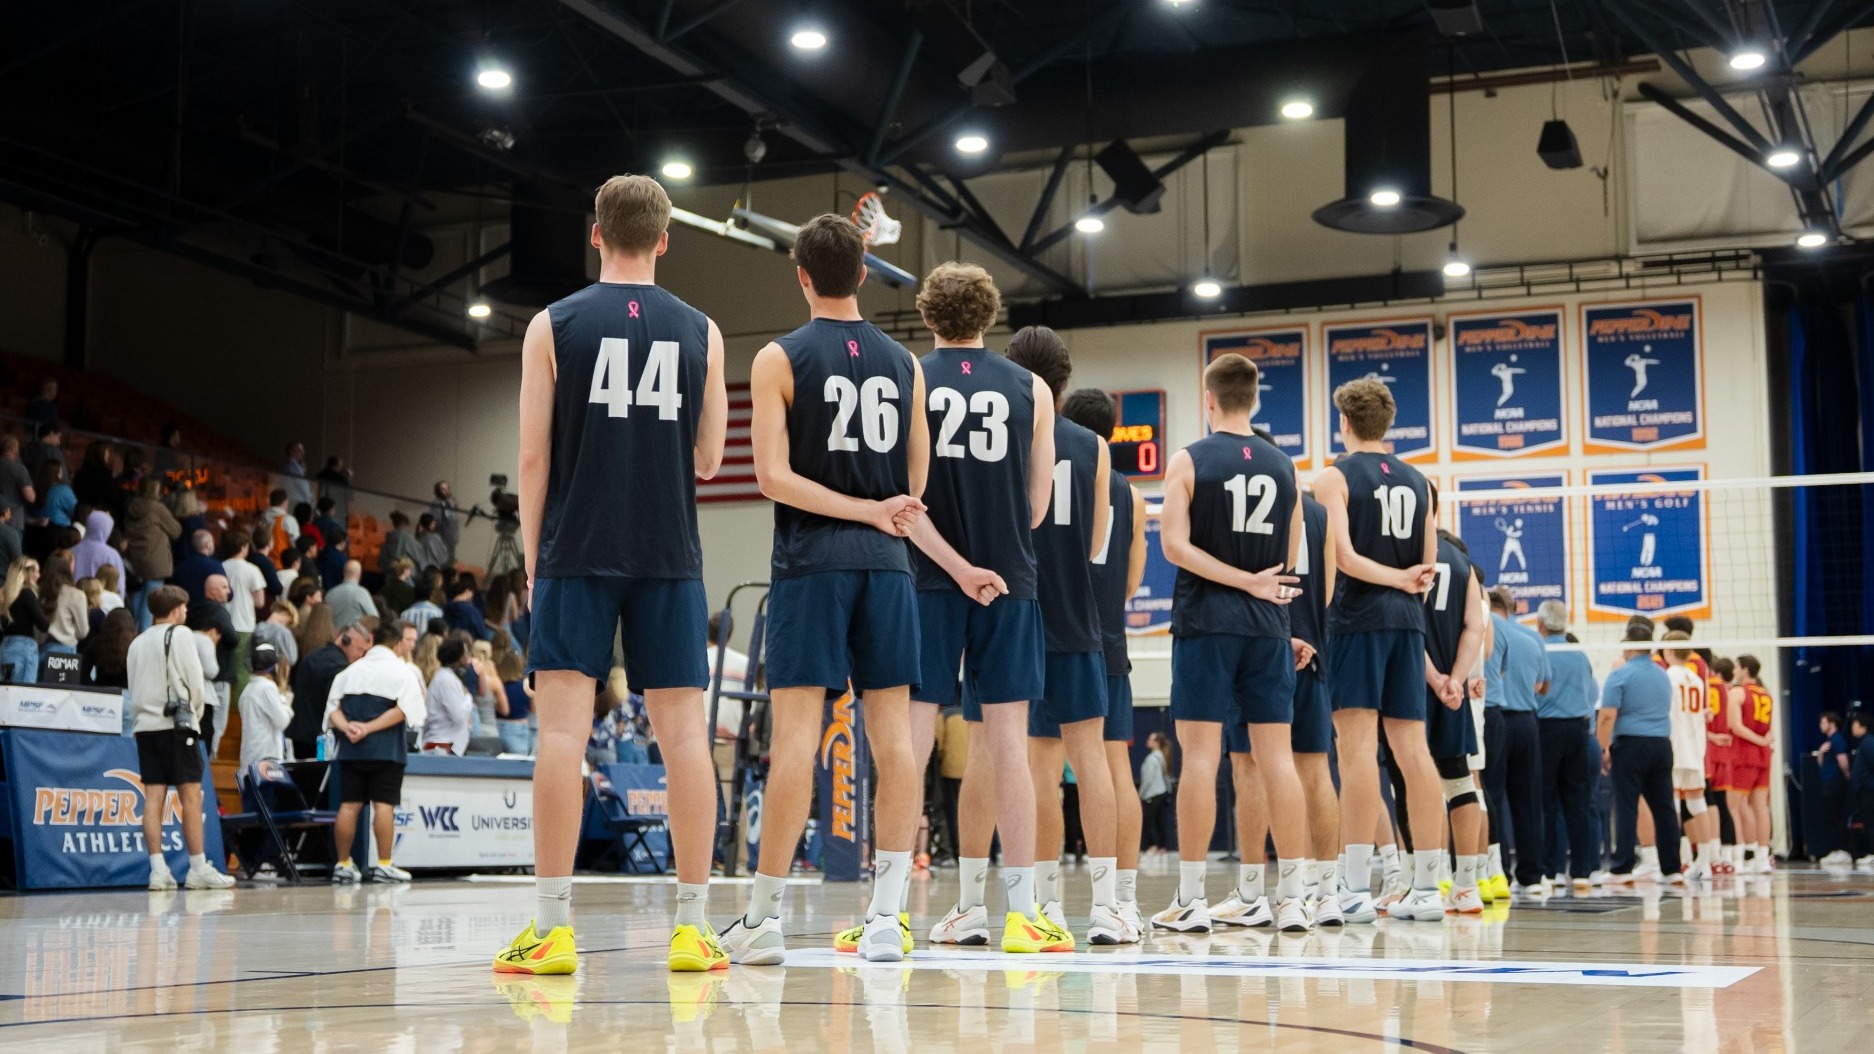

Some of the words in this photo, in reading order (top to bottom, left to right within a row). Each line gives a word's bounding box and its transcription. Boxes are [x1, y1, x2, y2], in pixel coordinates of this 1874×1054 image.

[588, 337, 682, 421] 44
[824, 375, 899, 453] 26
[1627, 399, 1659, 411] NCAA
[929, 387, 1009, 462] 23
[1461, 422, 1504, 436] NATIONAL
[1505, 419, 1558, 433] CHAMPIONS
[1594, 414, 1639, 428] NATIONAL
[1639, 411, 1693, 425] CHAMPIONS
[1138, 442, 1157, 472] 0
[1224, 474, 1277, 535] 12
[1374, 484, 1416, 539] 10
[1471, 505, 1508, 516] MEN'S
[1513, 503, 1555, 515] TENNIS
[1605, 498, 1648, 511] MEN'S
[1654, 497, 1690, 509] GOLF
[1630, 566, 1663, 578] NCAA
[1599, 581, 1644, 595] NATIONAL
[1644, 579, 1699, 593] CHAMPIONS
[47, 657, 80, 671] ROMAR
[1679, 685, 1700, 713] 10
[1752, 693, 1772, 724] 12
[471, 814, 535, 831] UNIVERSI
[62, 831, 183, 853] ATHLETCS
